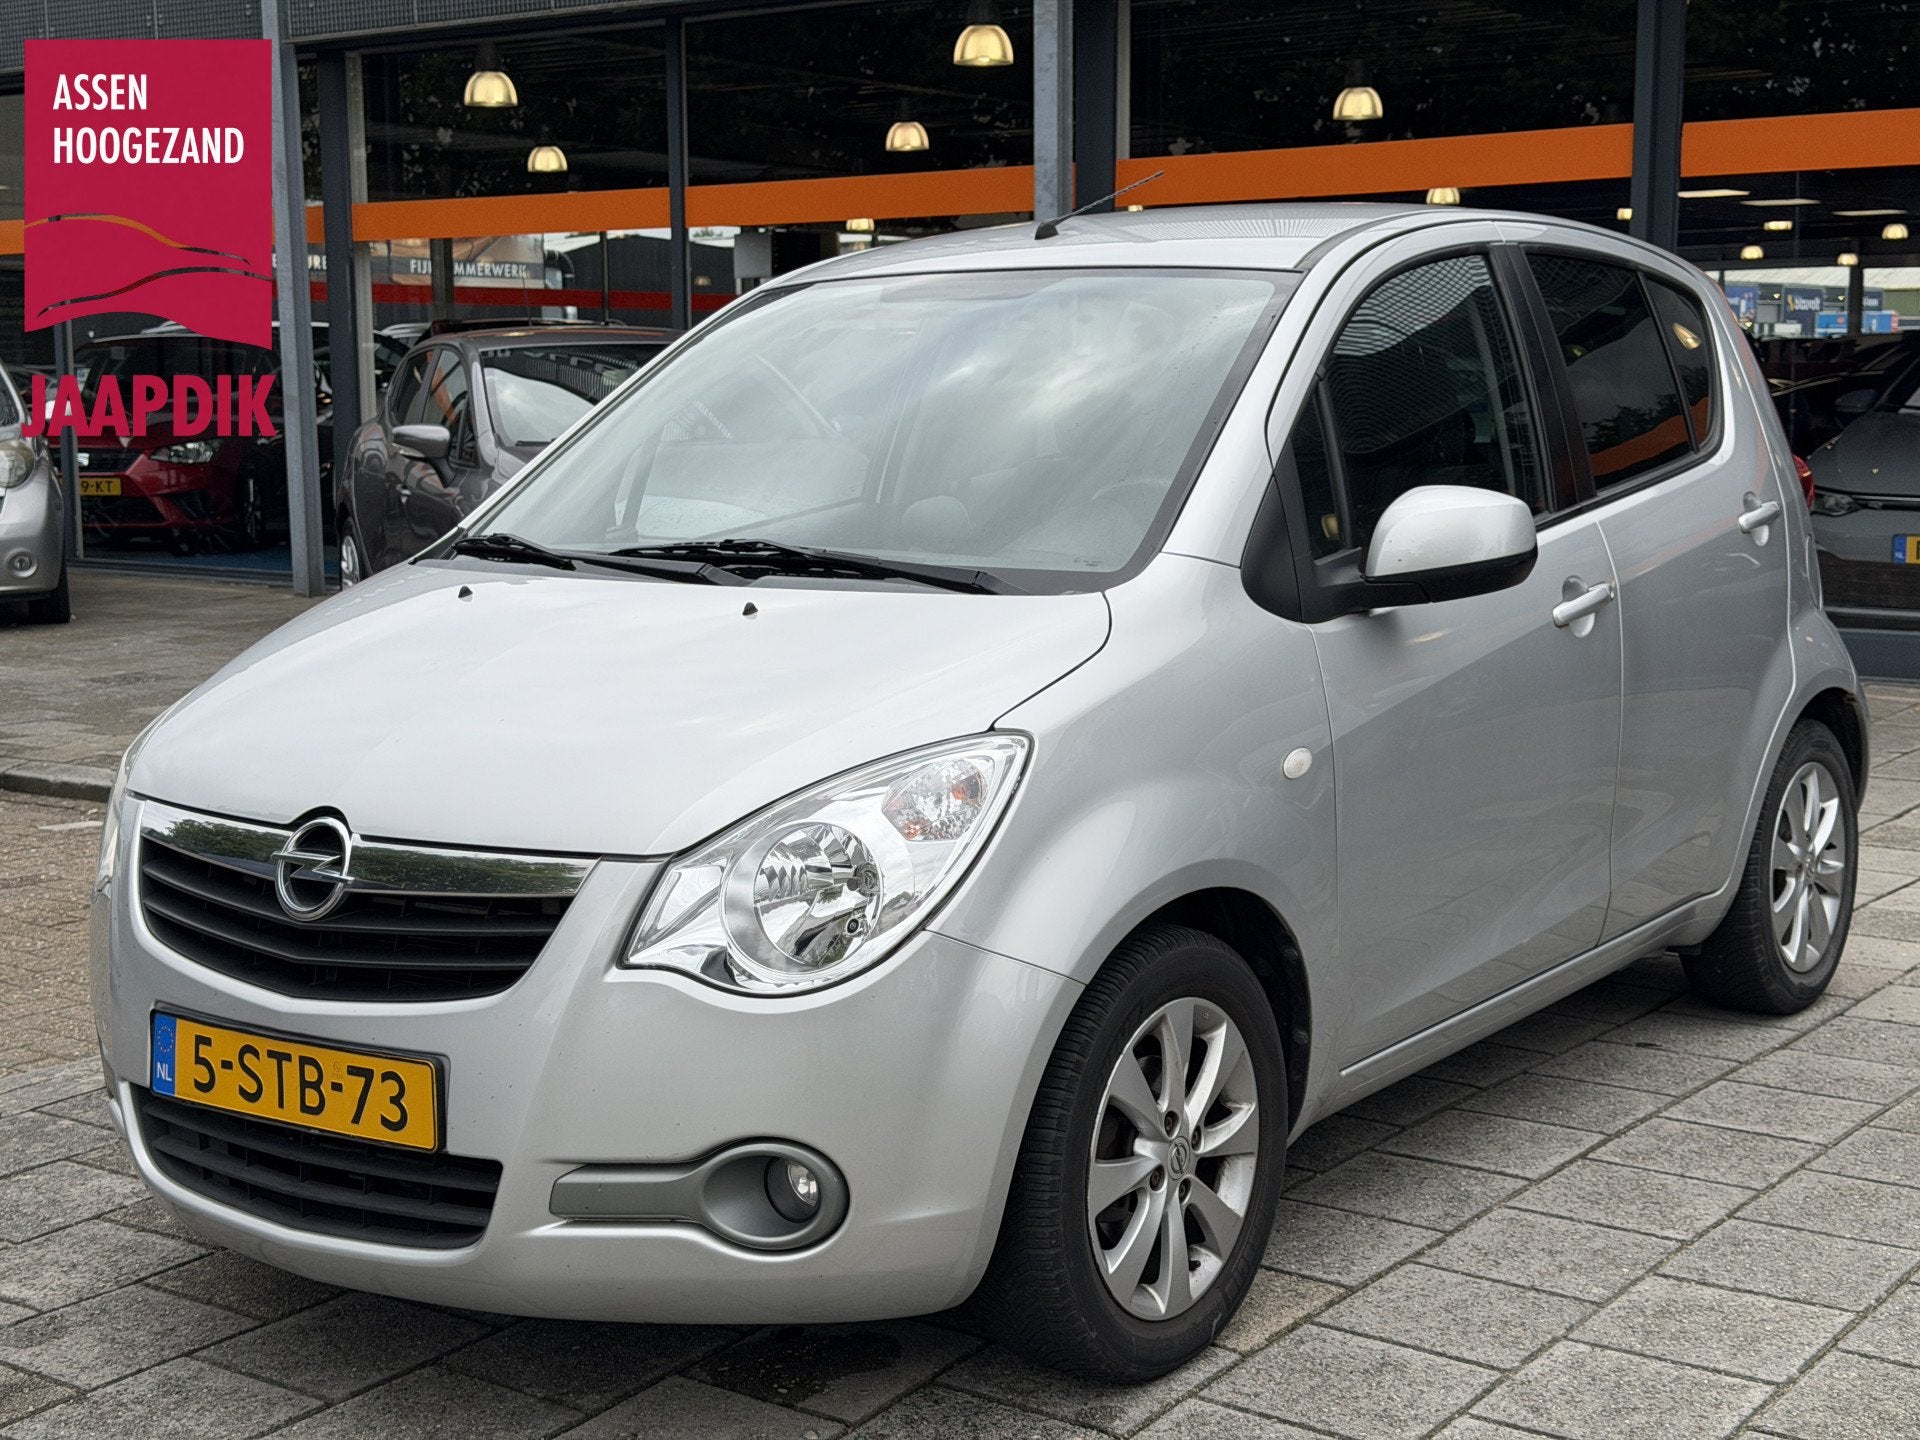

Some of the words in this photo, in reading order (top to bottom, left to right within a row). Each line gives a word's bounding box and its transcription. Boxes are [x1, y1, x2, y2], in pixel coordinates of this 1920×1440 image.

[410, 259, 526, 278] FIJMMERWERK
[80, 481, 113, 493] 9-KT
[156, 1061, 172, 1082] NL
[194, 1034, 408, 1132] 5-STB-73
